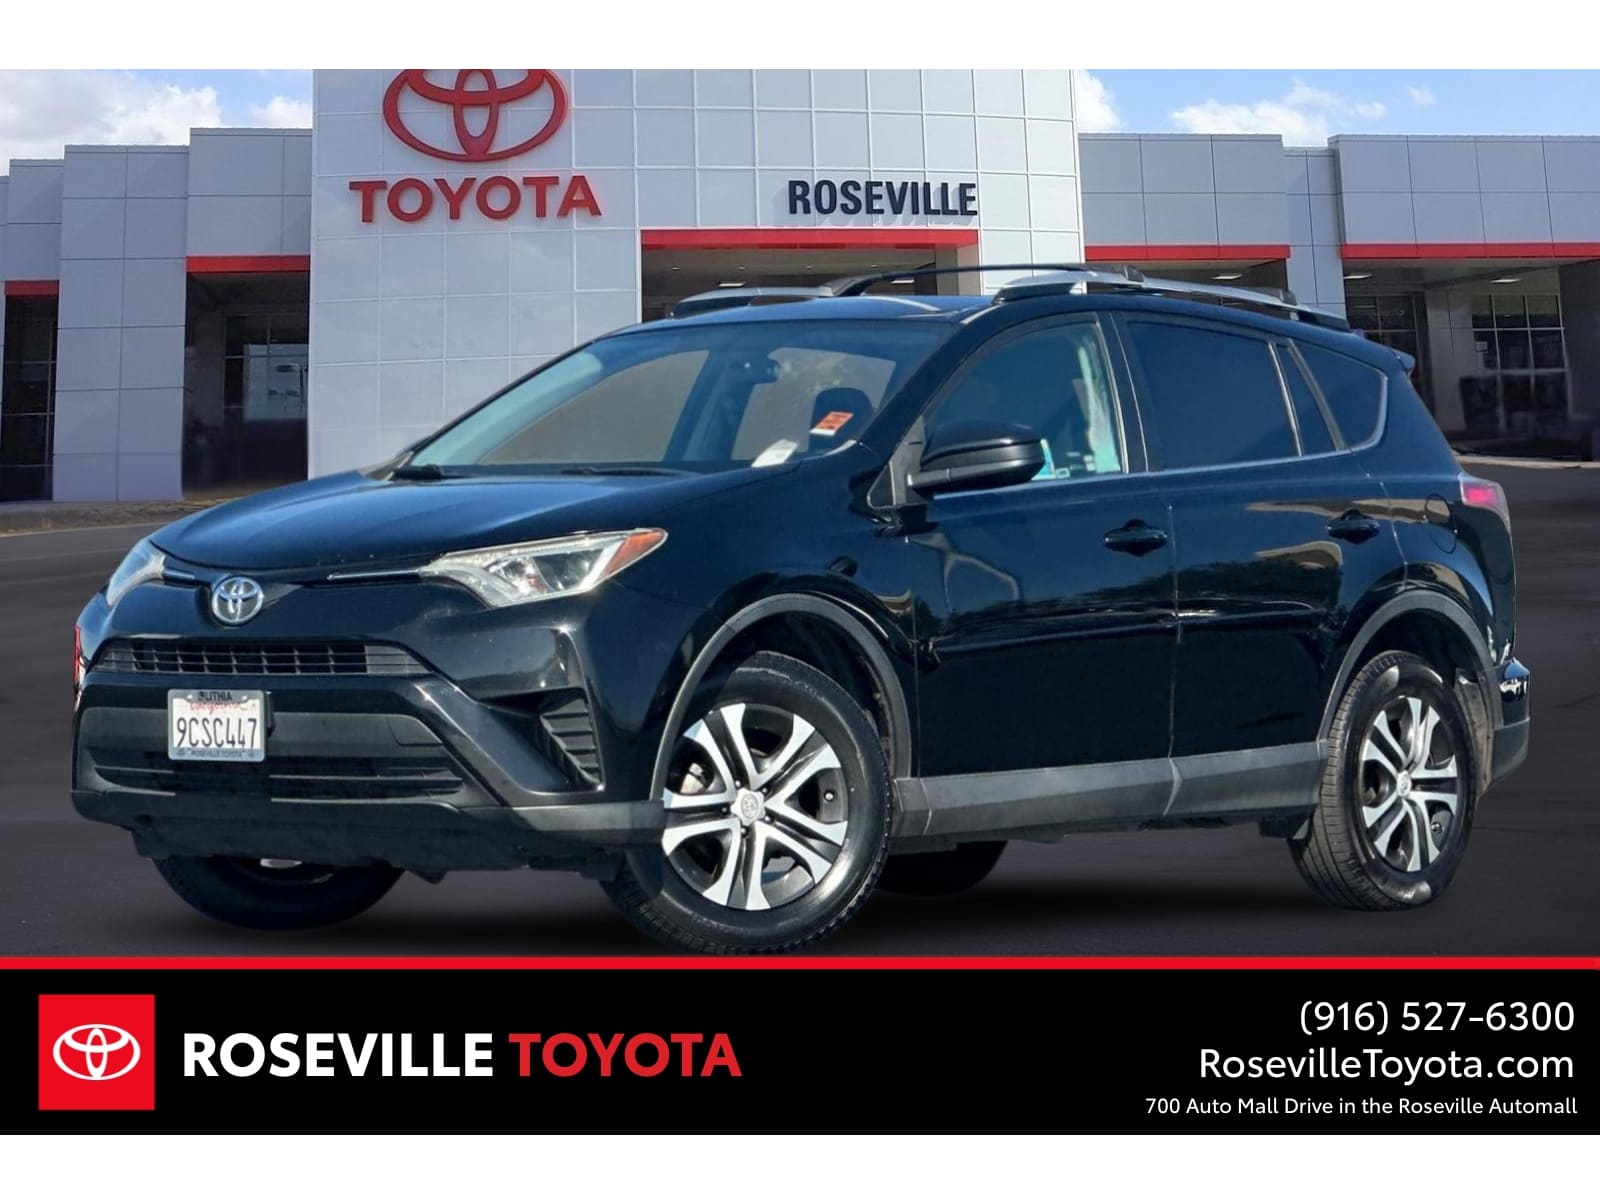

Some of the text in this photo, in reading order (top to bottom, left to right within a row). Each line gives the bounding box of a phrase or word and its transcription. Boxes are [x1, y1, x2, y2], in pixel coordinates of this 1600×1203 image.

[349, 175, 602, 223] TOYOTA
[788, 179, 978, 217] ROSEVILLE
[176, 717, 258, 748] 9CSC447
